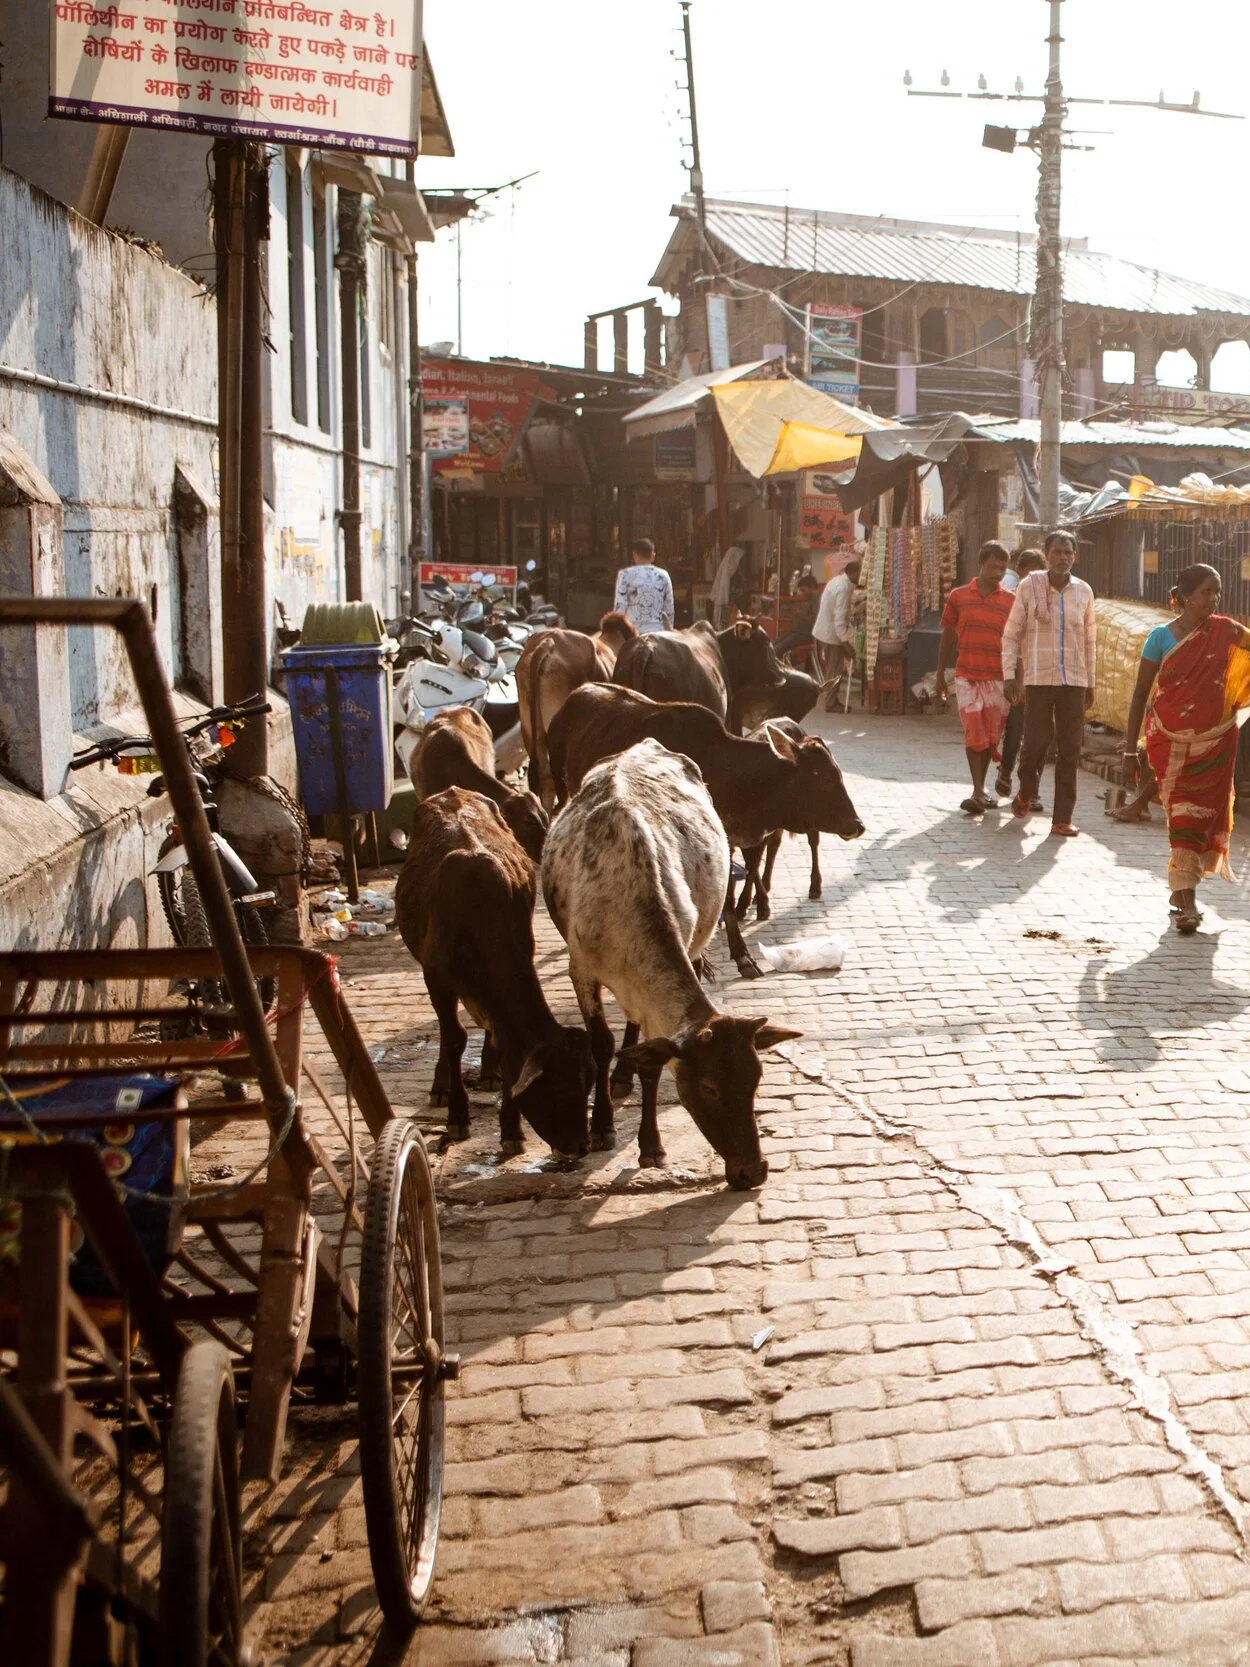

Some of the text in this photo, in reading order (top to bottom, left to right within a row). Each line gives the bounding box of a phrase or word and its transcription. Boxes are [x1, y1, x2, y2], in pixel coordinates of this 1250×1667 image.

[55, 0, 420, 71] पॉलिथीन का प्रयोग करते हुए पकड़े जाने पर
[339, 9, 370, 33] क्षेत्र
[82, 35, 394, 97] दोषियों के खिलाफ दण्डात्मक कार्यवाही
[144, 78, 192, 100] अमल
[196, 79, 214, 102] में
[220, 86, 264, 109] लायी
[827, 383, 854, 393] TICKET
